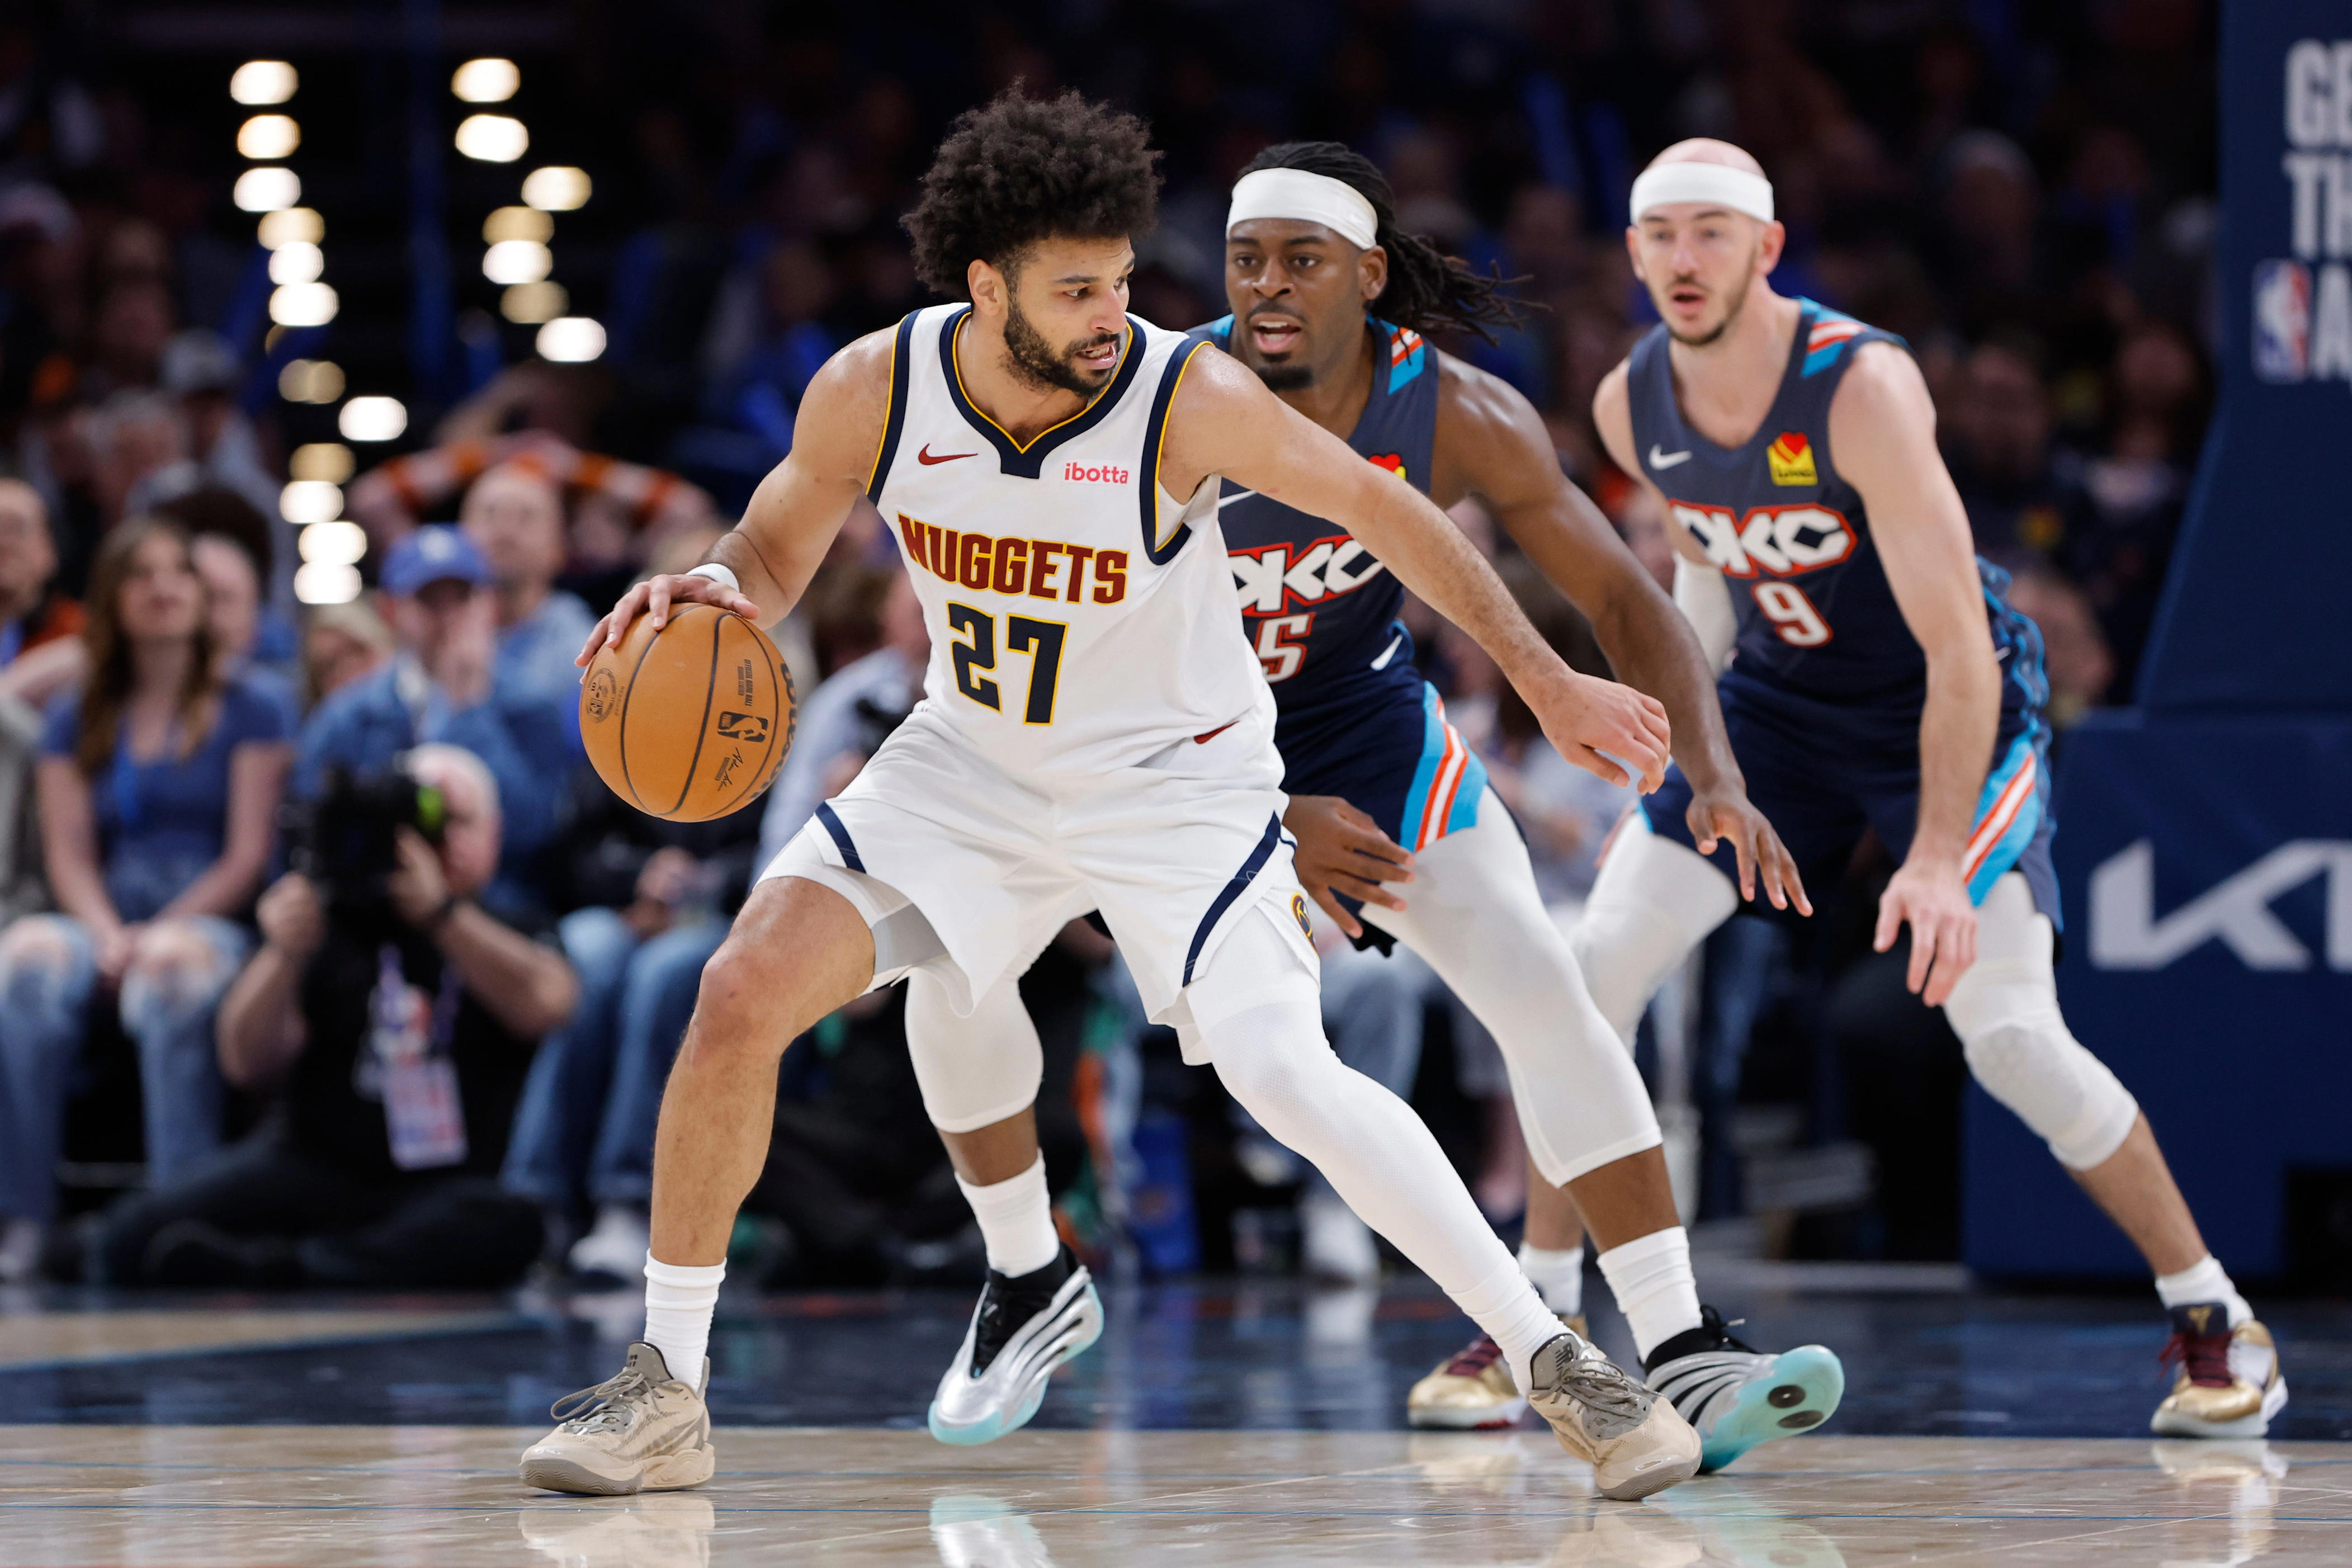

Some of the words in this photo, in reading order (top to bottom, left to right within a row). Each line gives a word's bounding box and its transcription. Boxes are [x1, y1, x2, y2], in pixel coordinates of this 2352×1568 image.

[1064, 461, 1128, 484] ibotta
[898, 511, 1130, 606] NUGGETS
[1254, 612, 1316, 684] 5
[1751, 580, 1834, 649] 9
[946, 601, 1069, 726] 27
